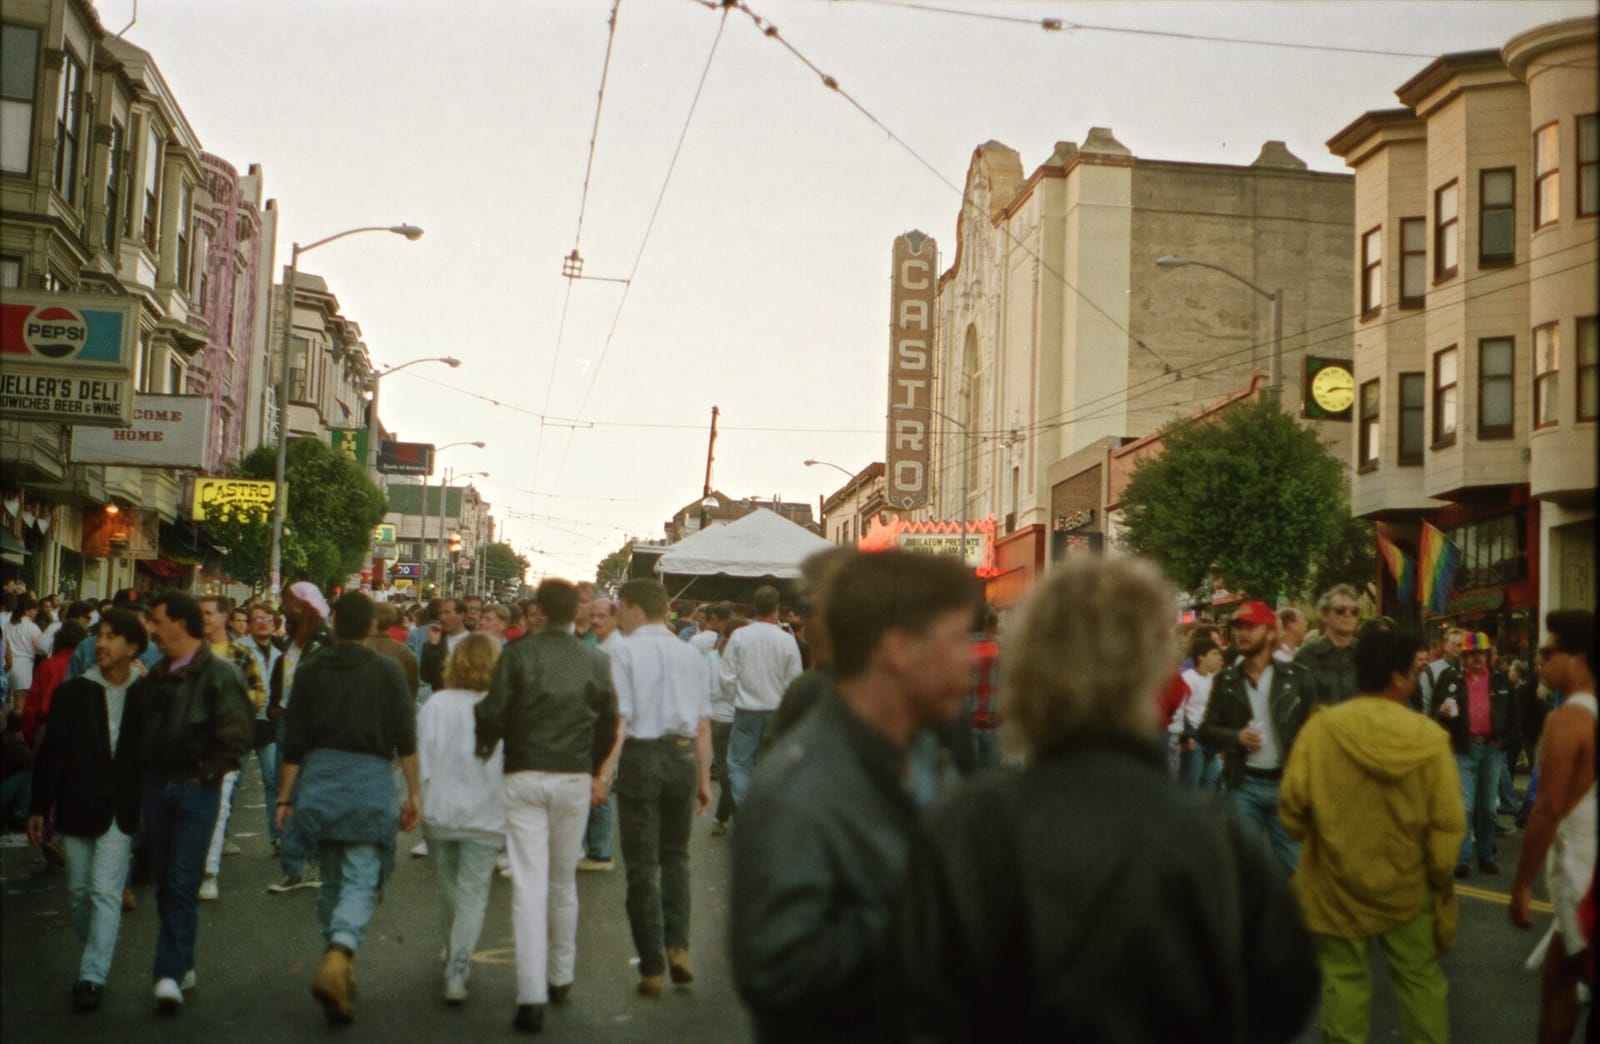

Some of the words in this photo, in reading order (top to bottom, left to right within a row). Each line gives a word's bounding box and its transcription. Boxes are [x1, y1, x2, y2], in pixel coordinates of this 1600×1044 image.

[28, 324, 85, 341] PEPSI
[894, 259, 929, 493] CASTRO
[79, 381, 118, 401] DELI
[0, 395, 50, 411] DWICHES
[54, 399, 82, 414] BEER
[93, 402, 121, 415] WINE
[113, 430, 164, 441] HOME
[202, 482, 271, 502] CASTRO
[945, 538, 980, 546] PRESNTS
